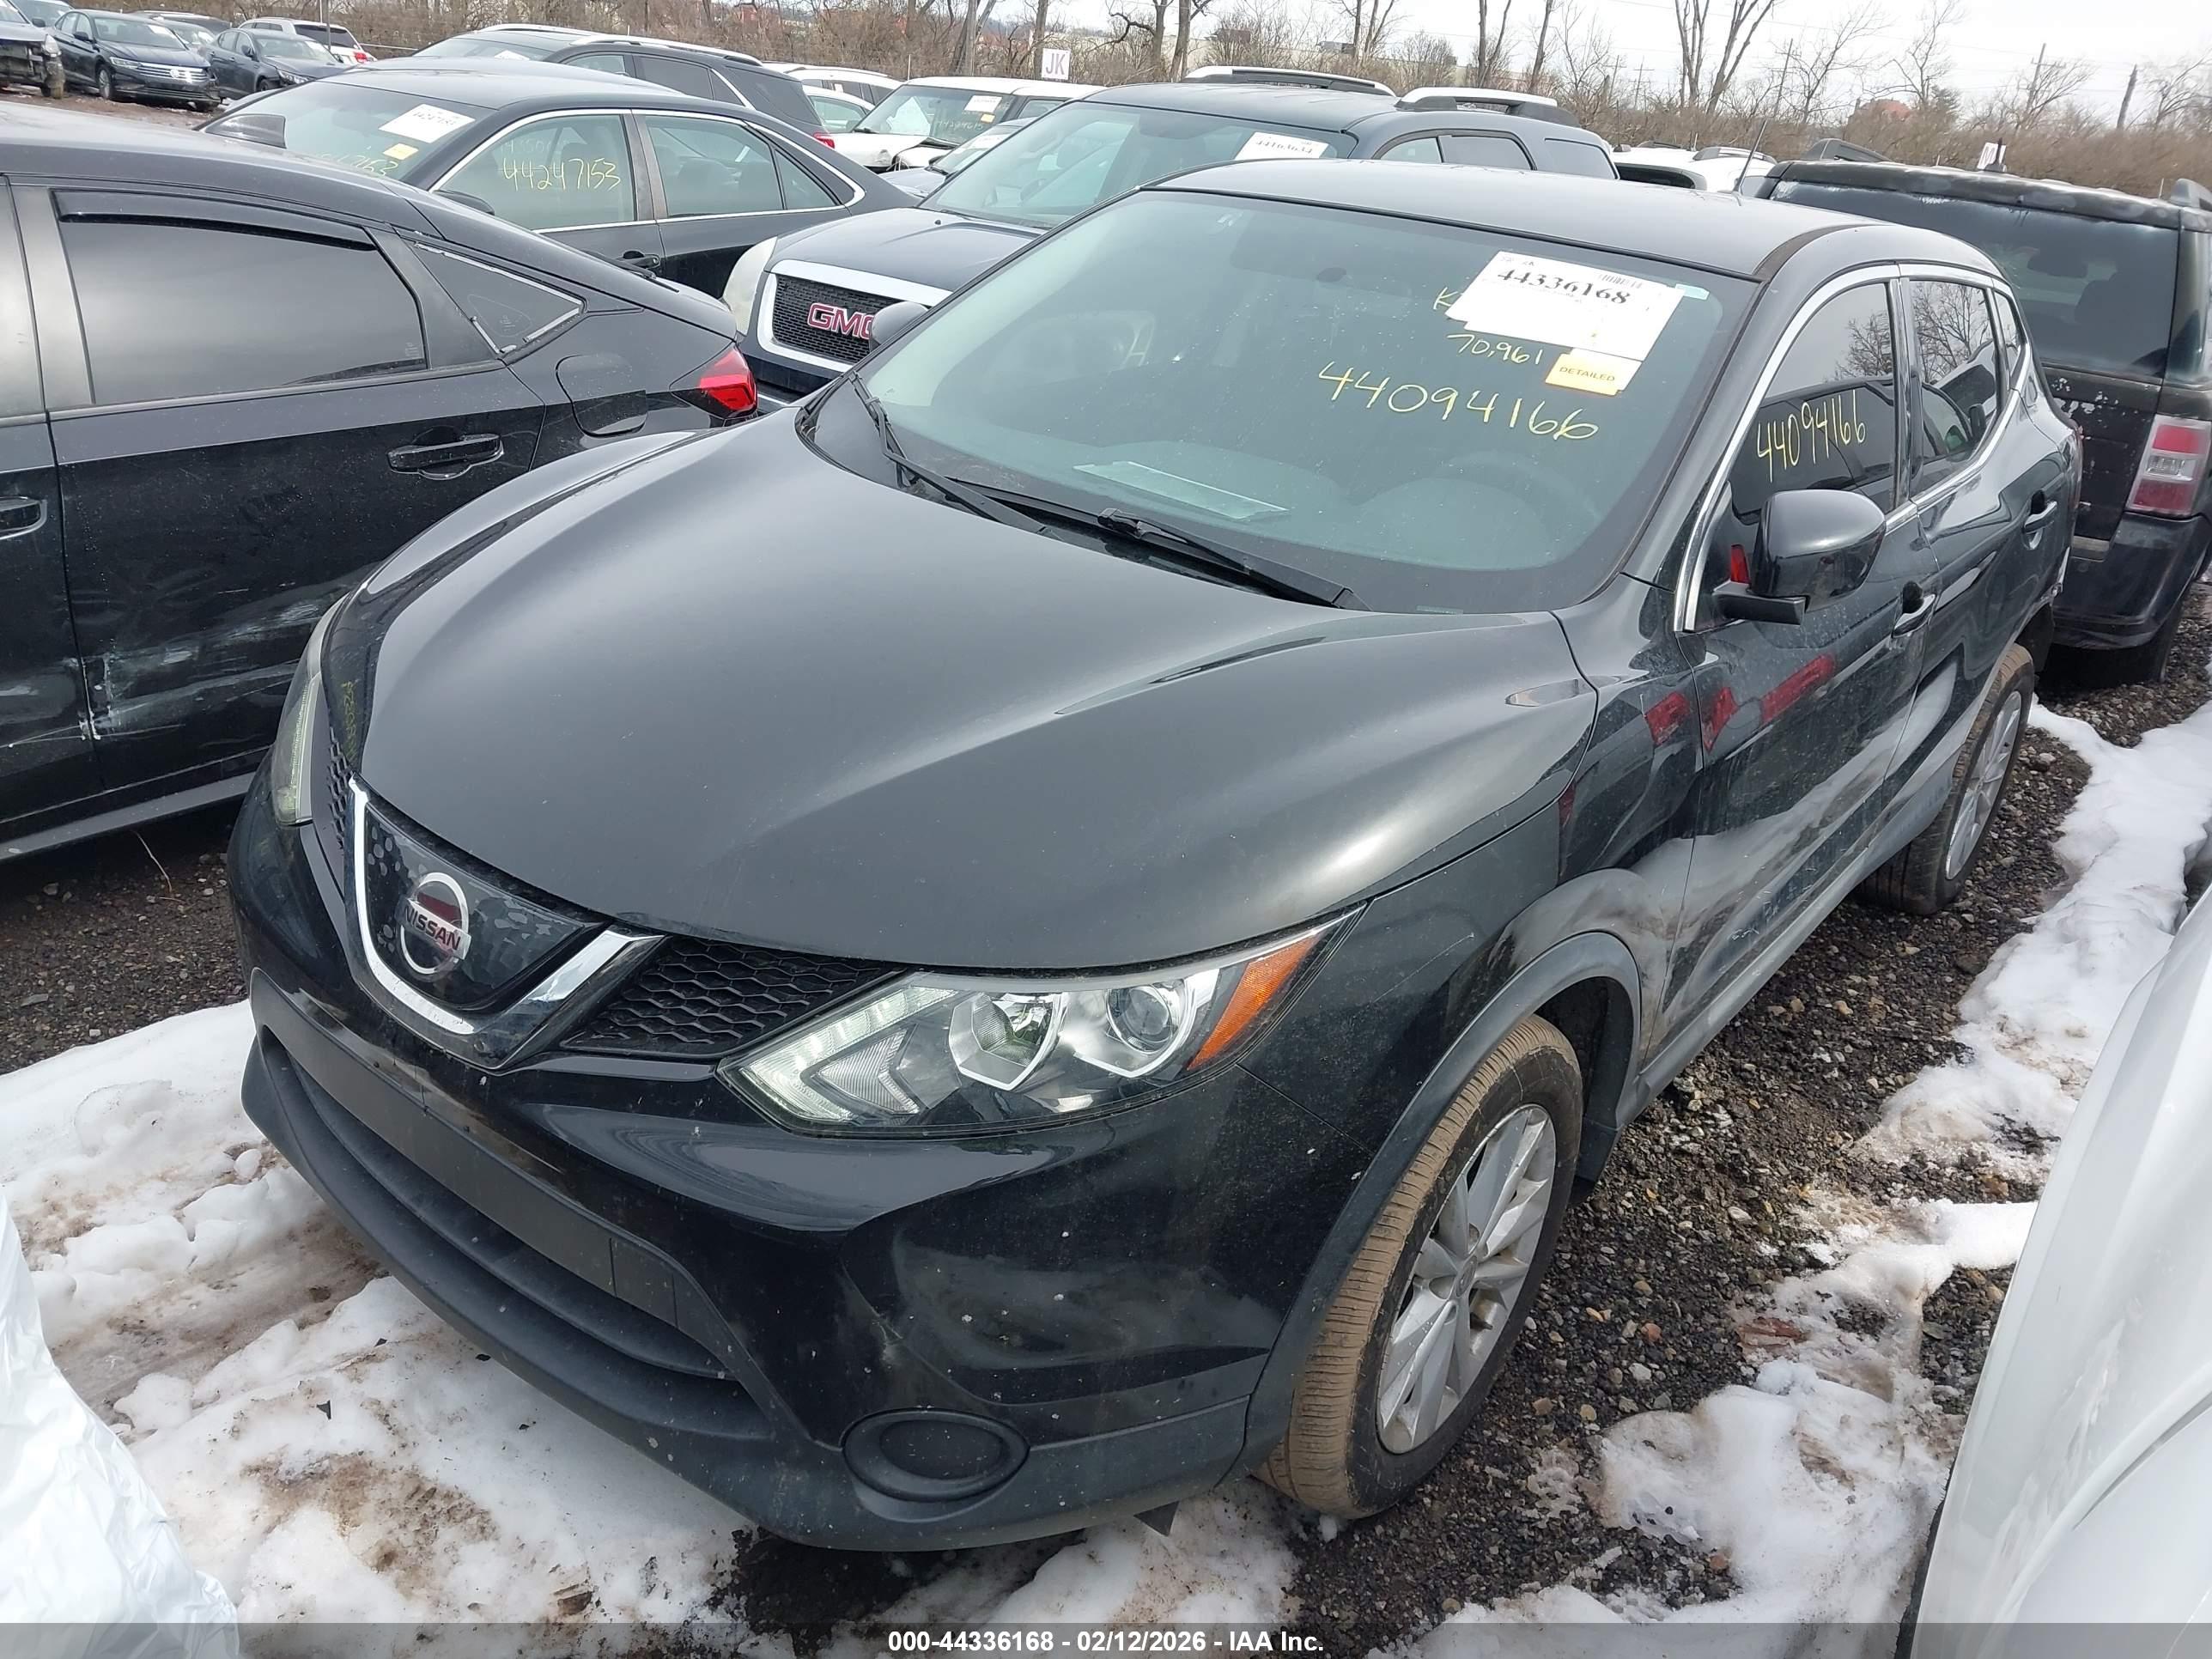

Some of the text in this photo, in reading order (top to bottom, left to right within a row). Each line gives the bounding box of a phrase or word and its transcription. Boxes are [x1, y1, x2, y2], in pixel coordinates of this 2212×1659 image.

[1045, 52, 1066, 76] JK
[503, 157, 622, 191] 44247153
[1498, 269, 1631, 304] 44336168
[1446, 333, 1544, 365] 70,961
[1559, 366, 1616, 383] DETAILED
[1318, 361, 1600, 441] 44094166
[1757, 389, 1866, 483] 44094166
[404, 904, 462, 951] NISSAN
